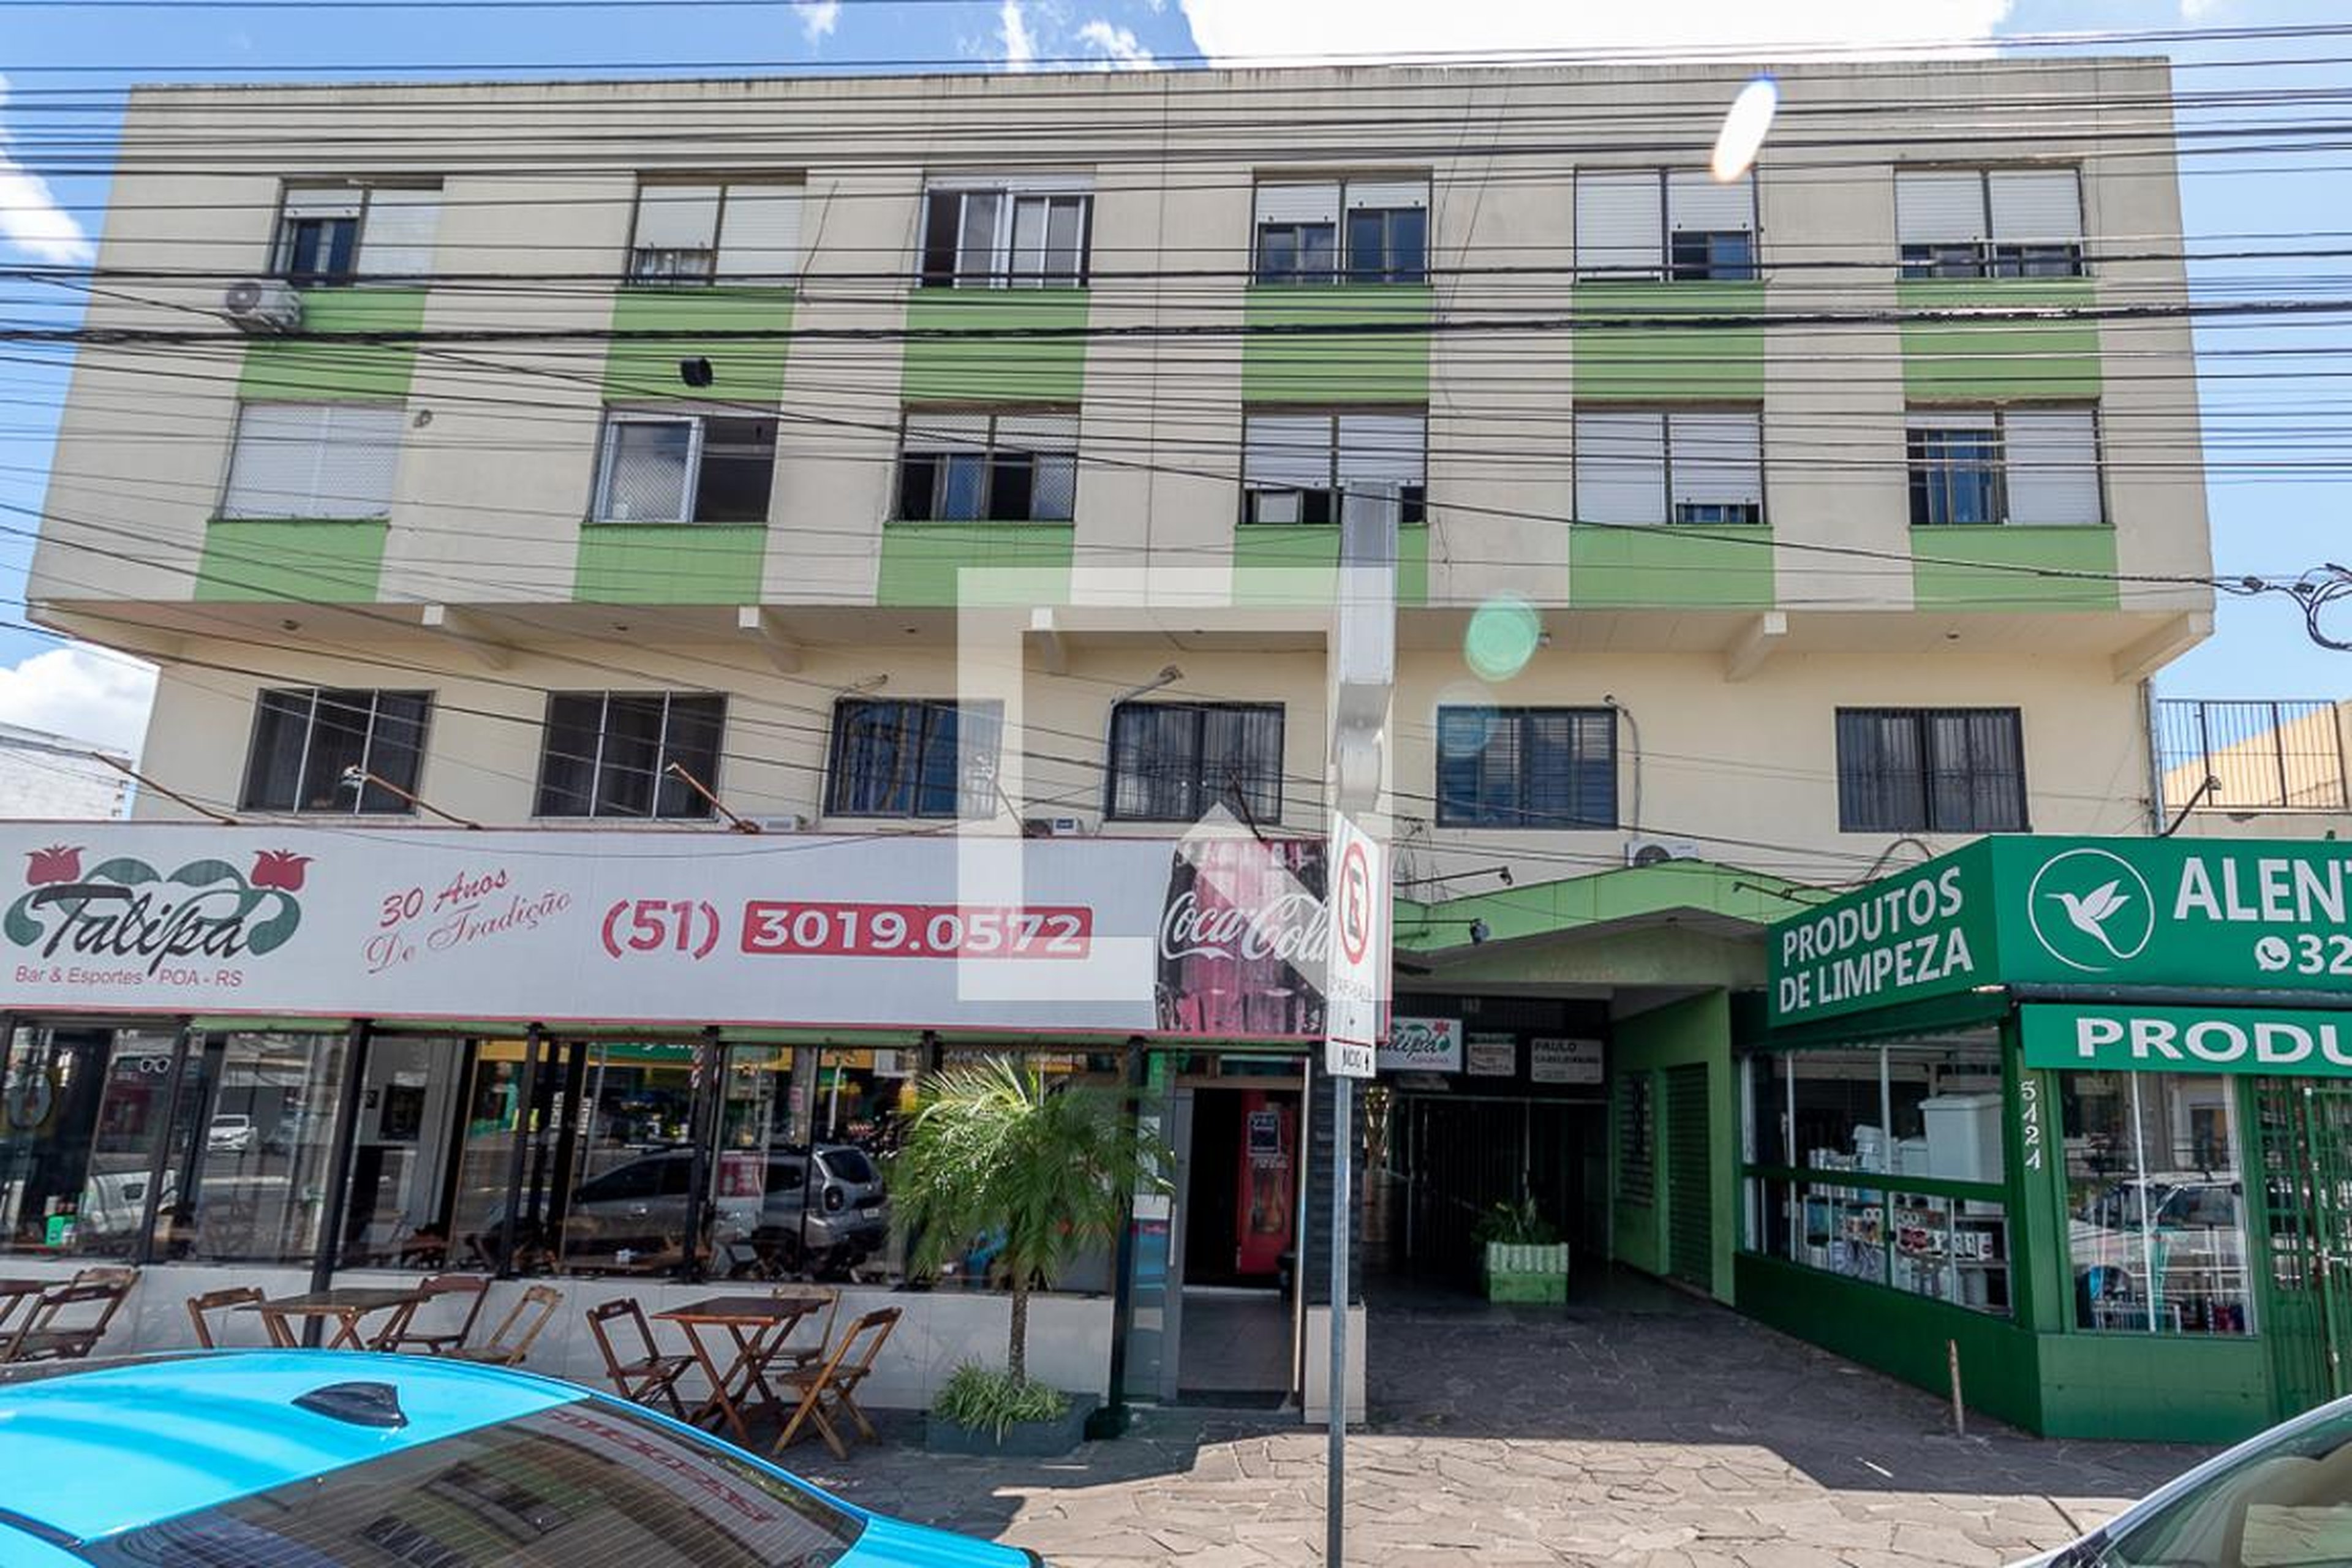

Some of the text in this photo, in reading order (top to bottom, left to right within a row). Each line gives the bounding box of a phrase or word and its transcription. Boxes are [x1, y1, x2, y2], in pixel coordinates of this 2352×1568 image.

[380, 869, 508, 927] 30 Anos
[1782, 865, 1963, 968] PRODUTOS
[2173, 857, 2352, 923] ALEN
[362, 892, 571, 974] De Tradição
[602, 899, 1084, 960] (51) 3019.0572
[15, 966, 44, 982] Bar
[49, 968, 61, 983] &
[68, 967, 143, 986] Esportes
[159, 970, 198, 986] POA
[215, 970, 243, 987] RS
[1779, 927, 1974, 1014] DE LIMPEZA
